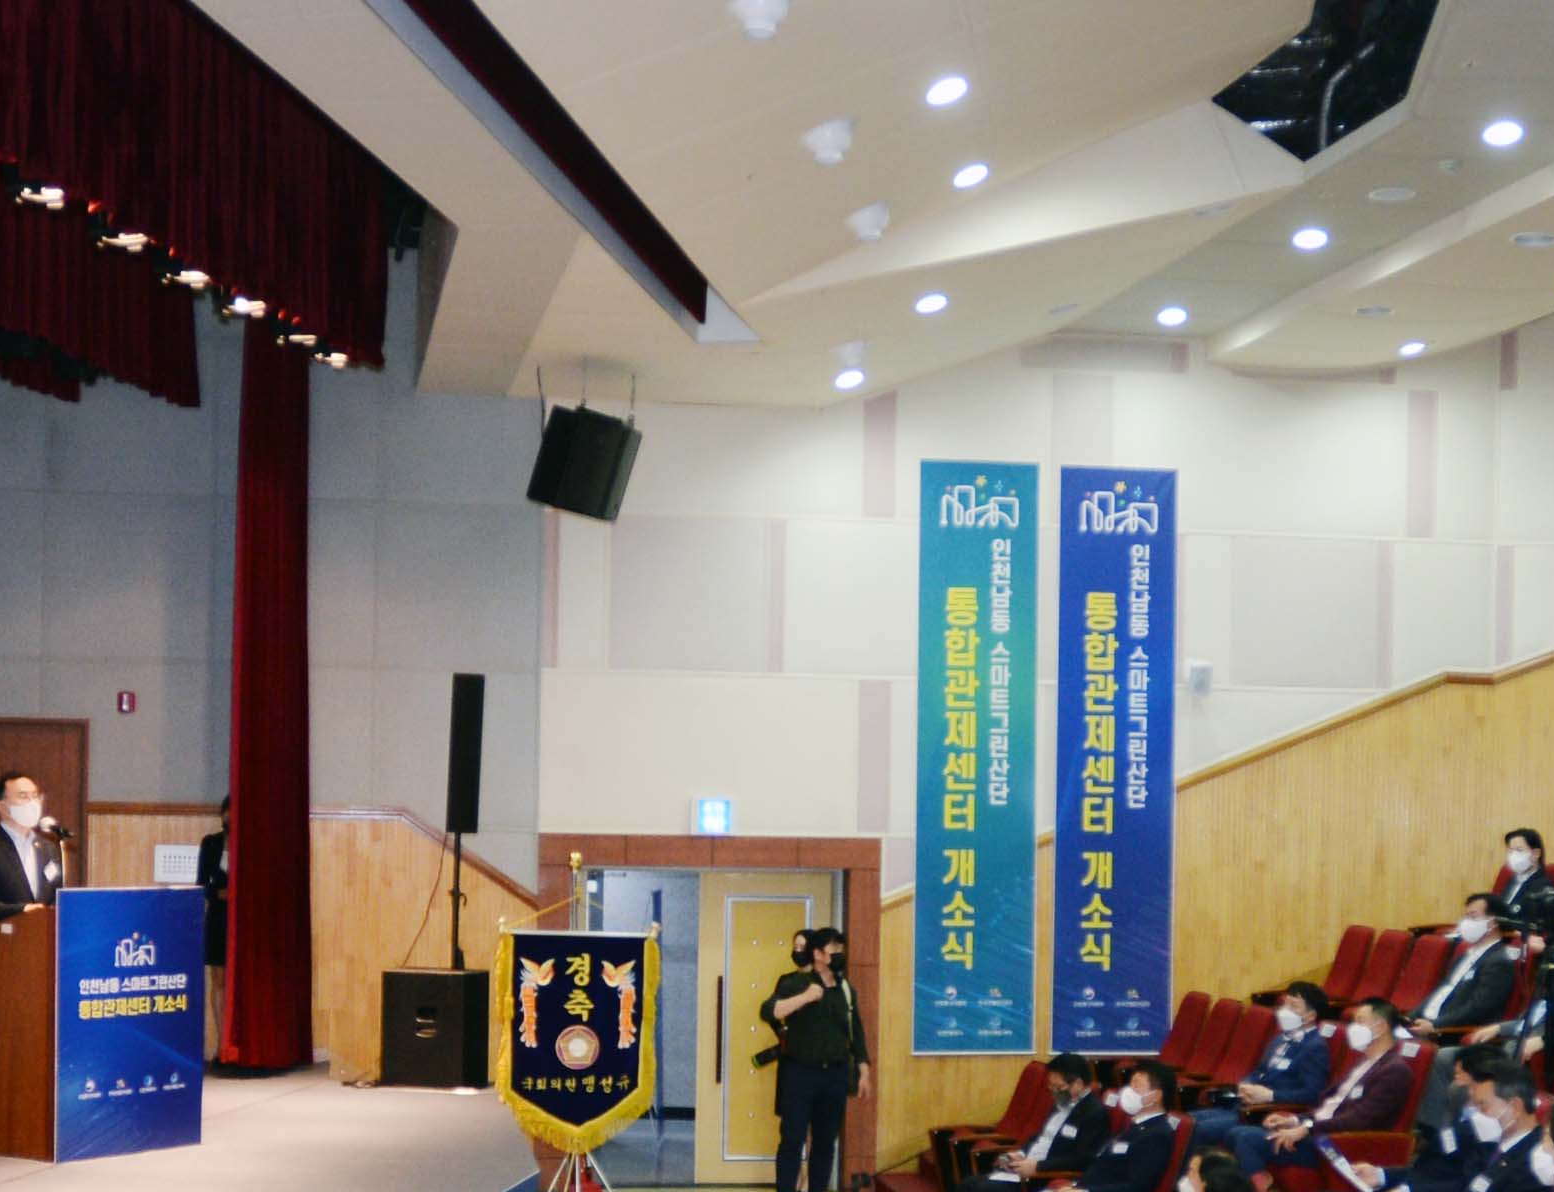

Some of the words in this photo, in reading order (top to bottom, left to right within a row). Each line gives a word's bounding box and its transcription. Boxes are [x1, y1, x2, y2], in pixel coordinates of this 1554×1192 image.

[990, 538, 1013, 634] 인천남동
[1127, 544, 1151, 639] 인천남동
[942, 586, 980, 832] 통합관제센터
[988, 641, 1012, 806] 스마트그린산단
[1081, 591, 1120, 834] 통합관제센터
[1126, 646, 1150, 809] 스마트그린산단
[941, 848, 976, 970] 개소식
[1079, 852, 1114, 972] 개소식
[153, 993, 187, 1013] 개소식
[563, 952, 595, 1022] 경축
